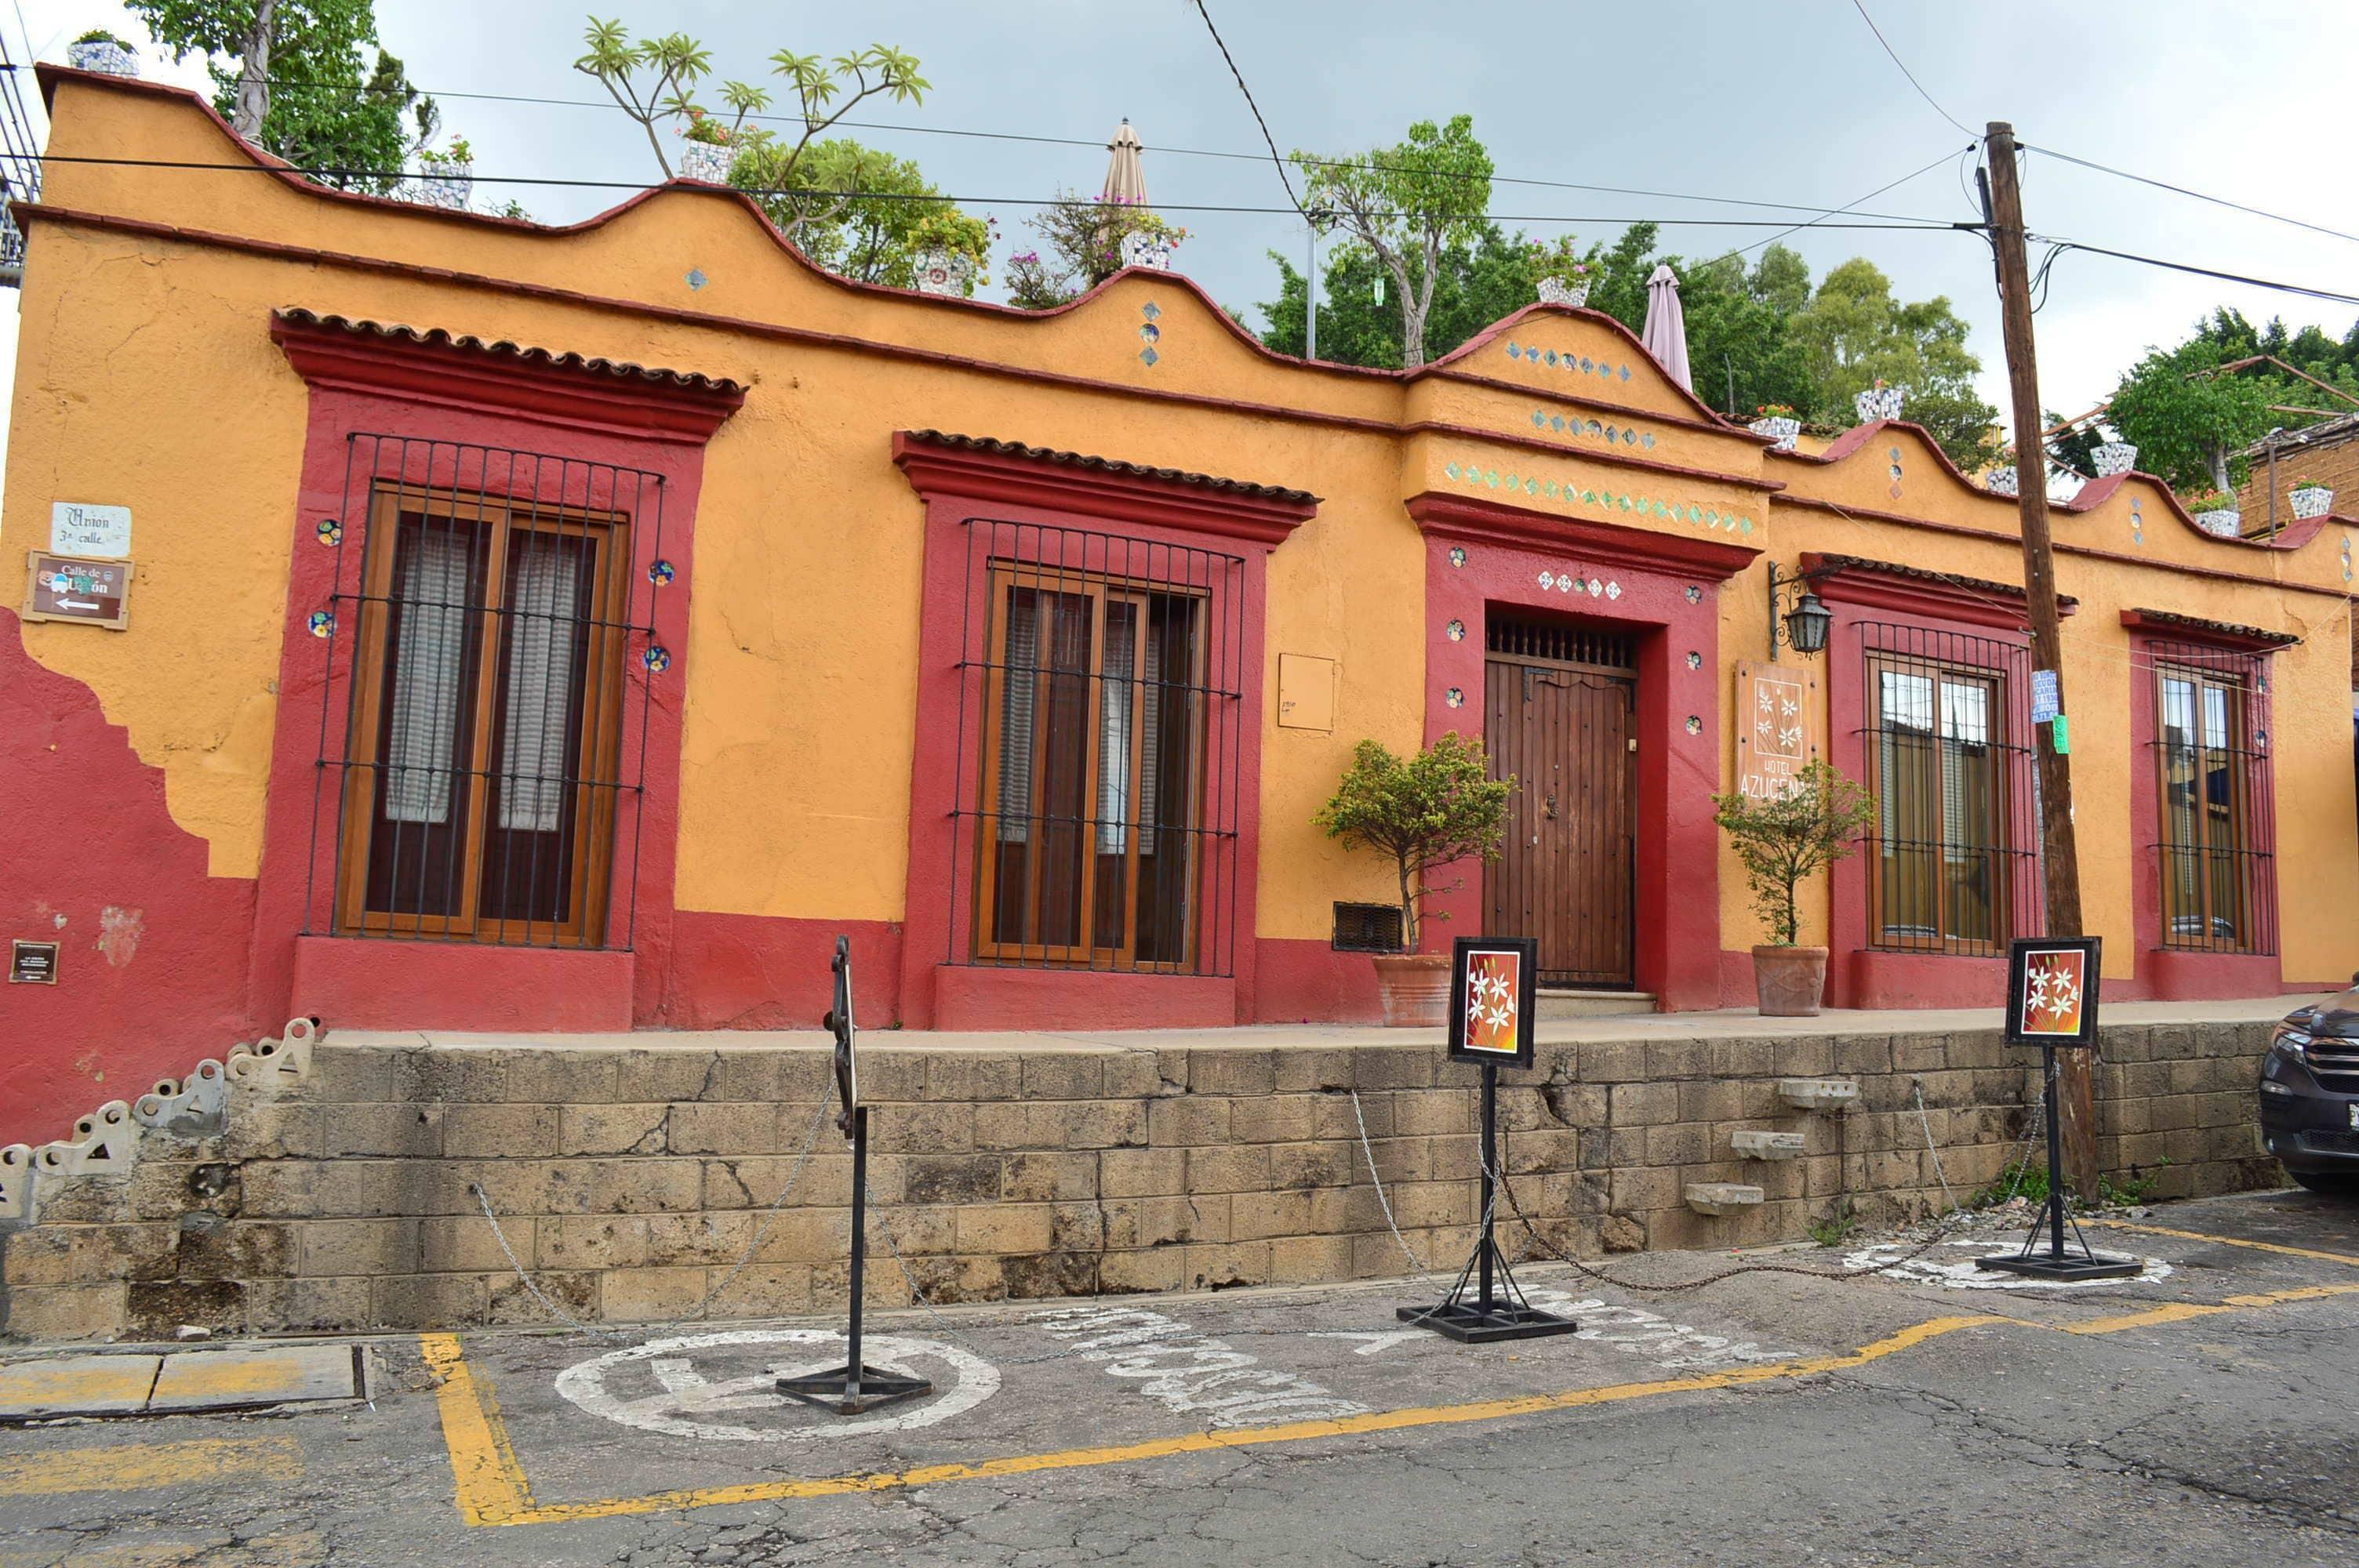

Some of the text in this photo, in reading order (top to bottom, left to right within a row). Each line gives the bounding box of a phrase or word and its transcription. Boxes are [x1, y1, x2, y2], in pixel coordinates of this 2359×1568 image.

[61, 564, 100, 578] Calle de
[68, 577, 108, 593] Uón
[1765, 760, 1793, 775] HOTEL
